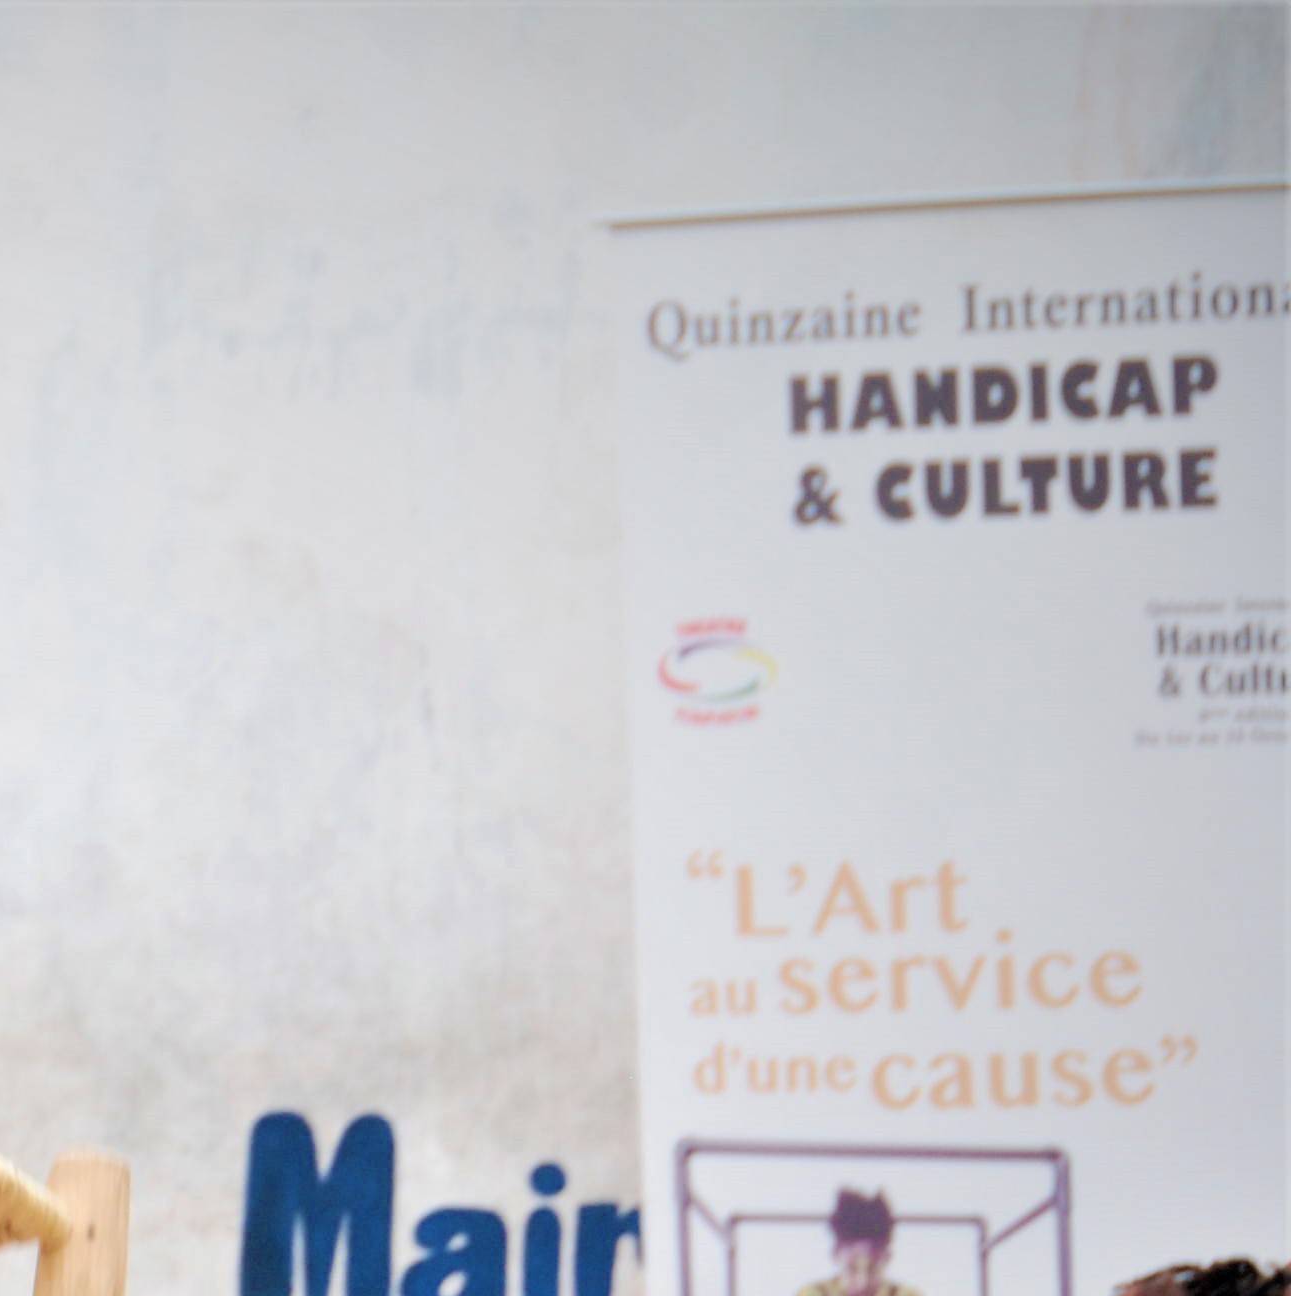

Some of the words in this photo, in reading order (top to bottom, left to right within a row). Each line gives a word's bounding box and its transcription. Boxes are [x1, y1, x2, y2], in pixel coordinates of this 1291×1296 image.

[646, 291, 923, 361] Quinzaine
[790, 354, 1220, 433] HANDICAP
[793, 465, 843, 526] &
[875, 447, 1219, 521] CULTURE
[691, 977, 759, 1016] au
[778, 929, 1144, 1014] service
